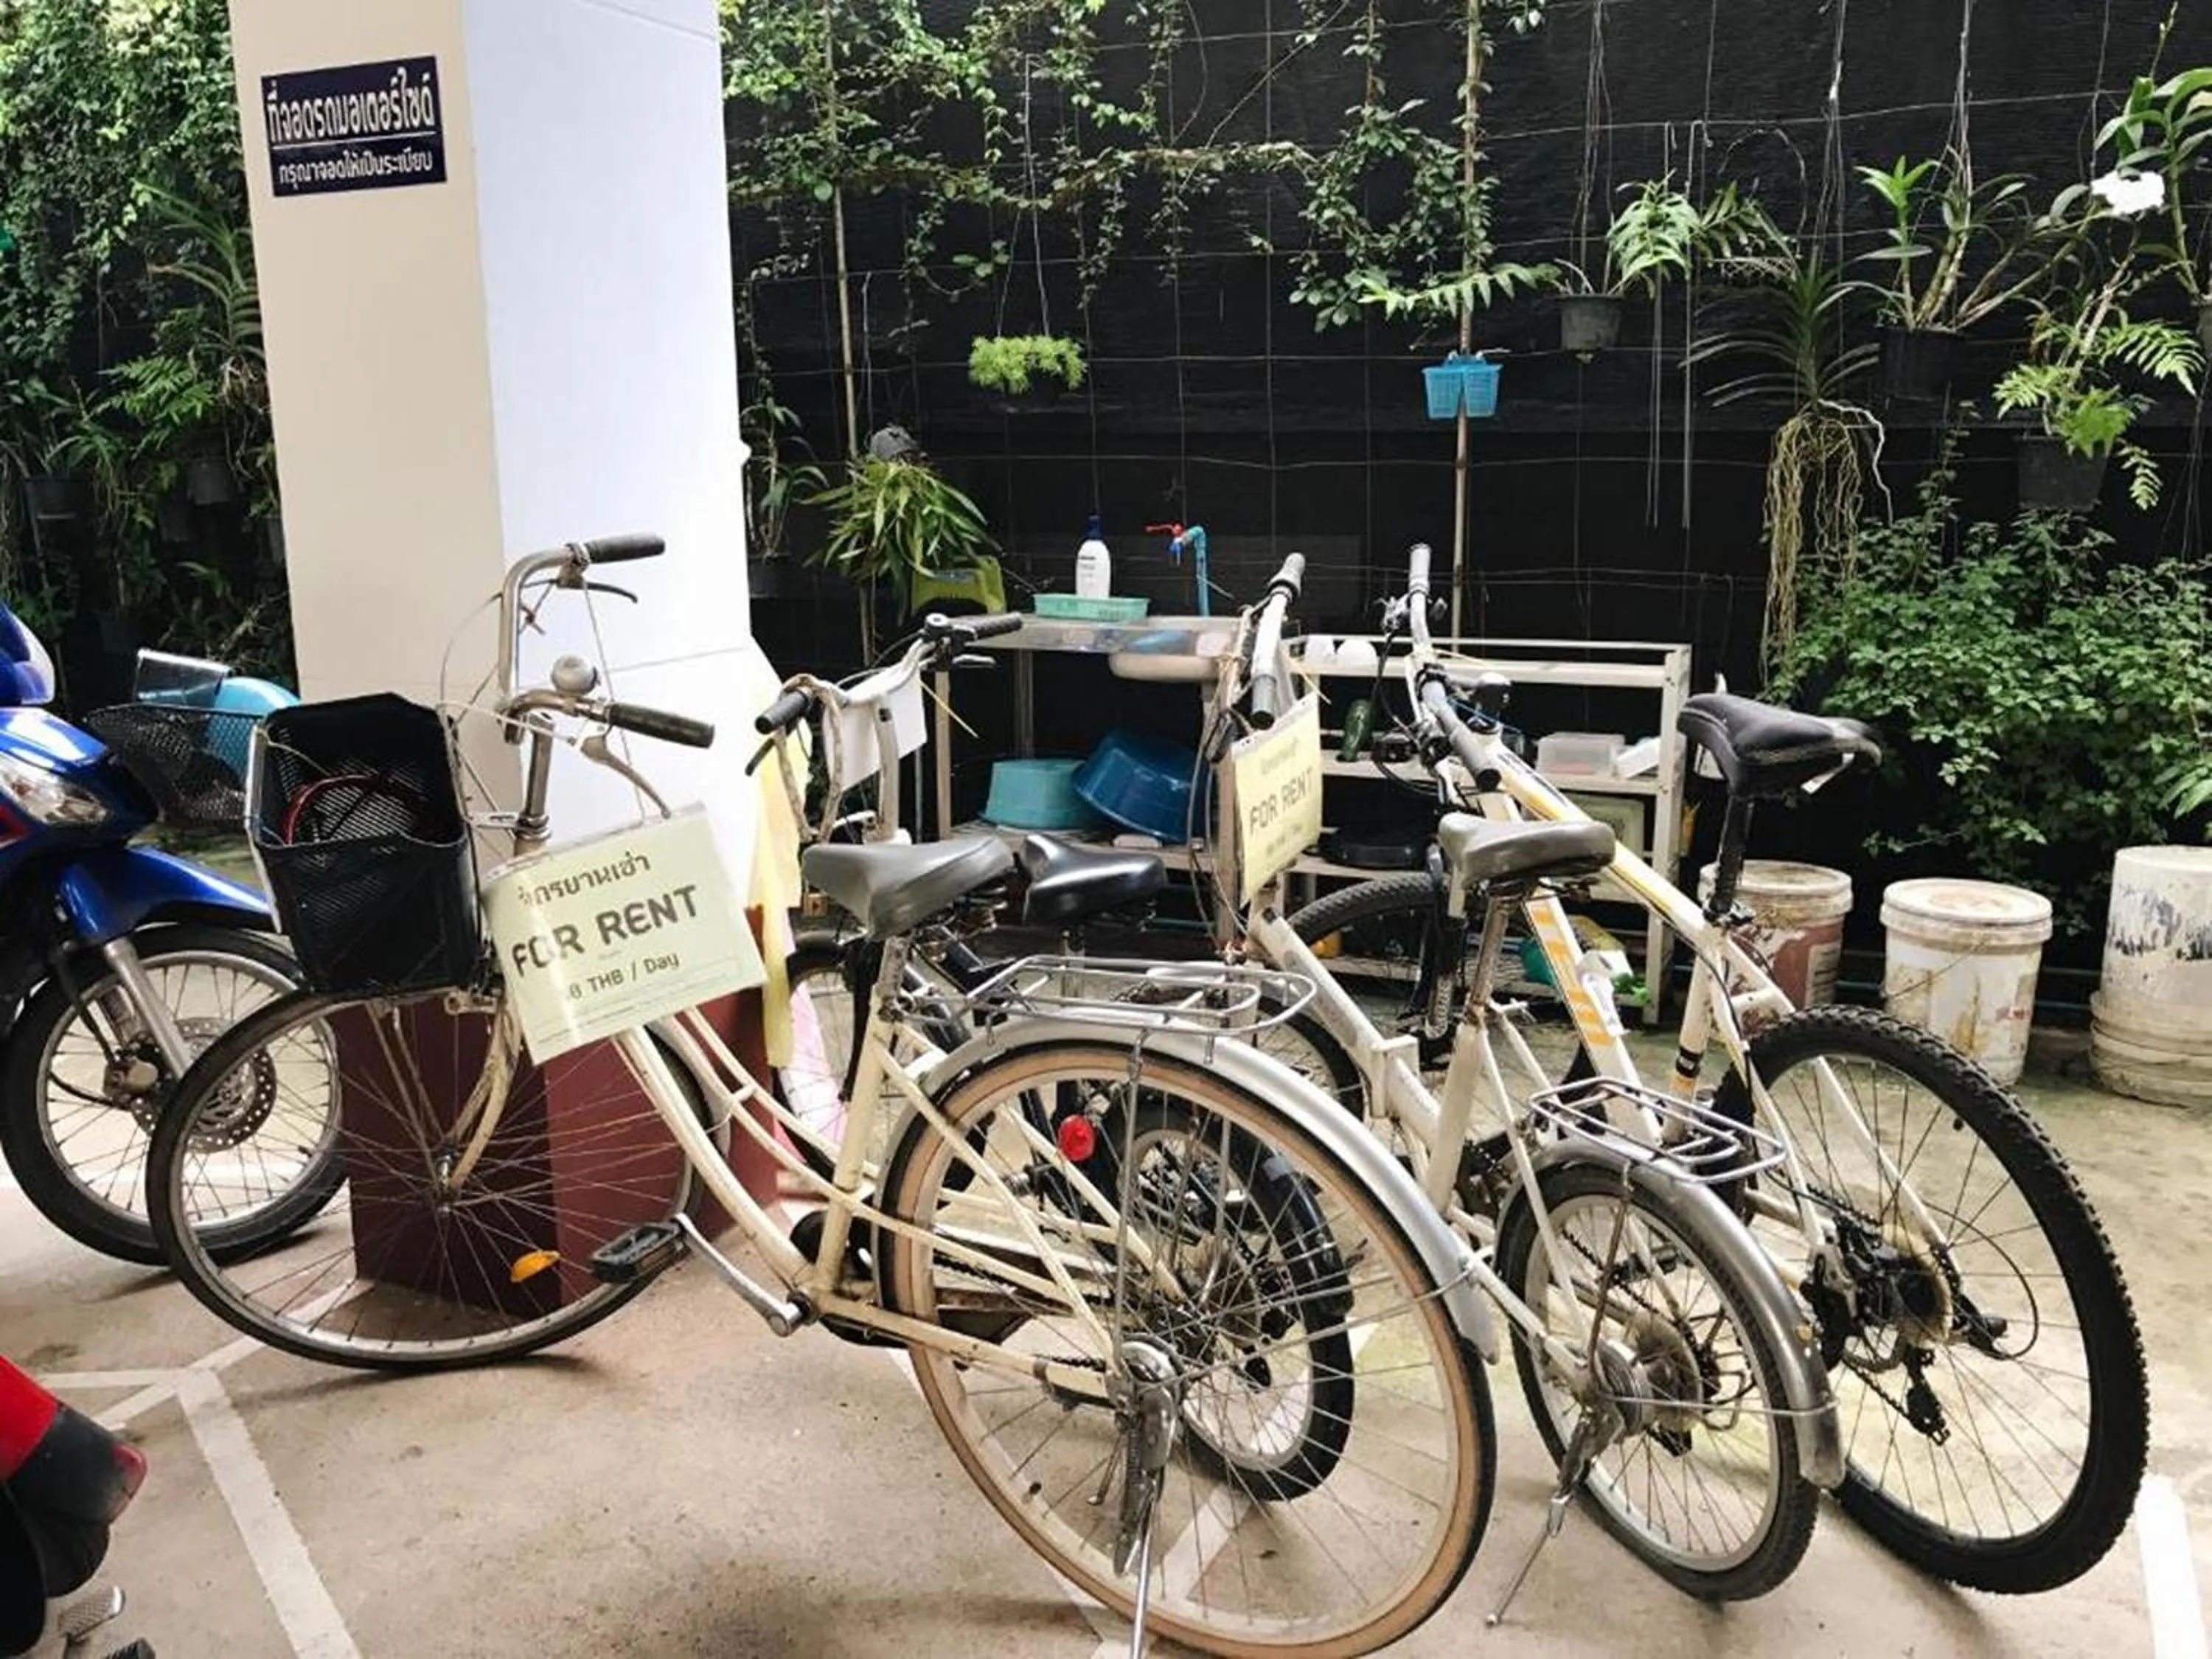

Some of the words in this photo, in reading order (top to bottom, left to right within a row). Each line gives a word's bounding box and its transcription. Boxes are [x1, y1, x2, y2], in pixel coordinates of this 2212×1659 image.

[280, 147, 433, 189] กรุณาจอดให้เป็นระเบียบ
[1249, 793, 1279, 836] FOR
[1281, 765, 1313, 813] RENT
[511, 923, 586, 978] FOR
[595, 885, 697, 946] RENT
[587, 968, 625, 992] THB
[631, 960, 637, 981] /
[643, 953, 680, 974] Day
